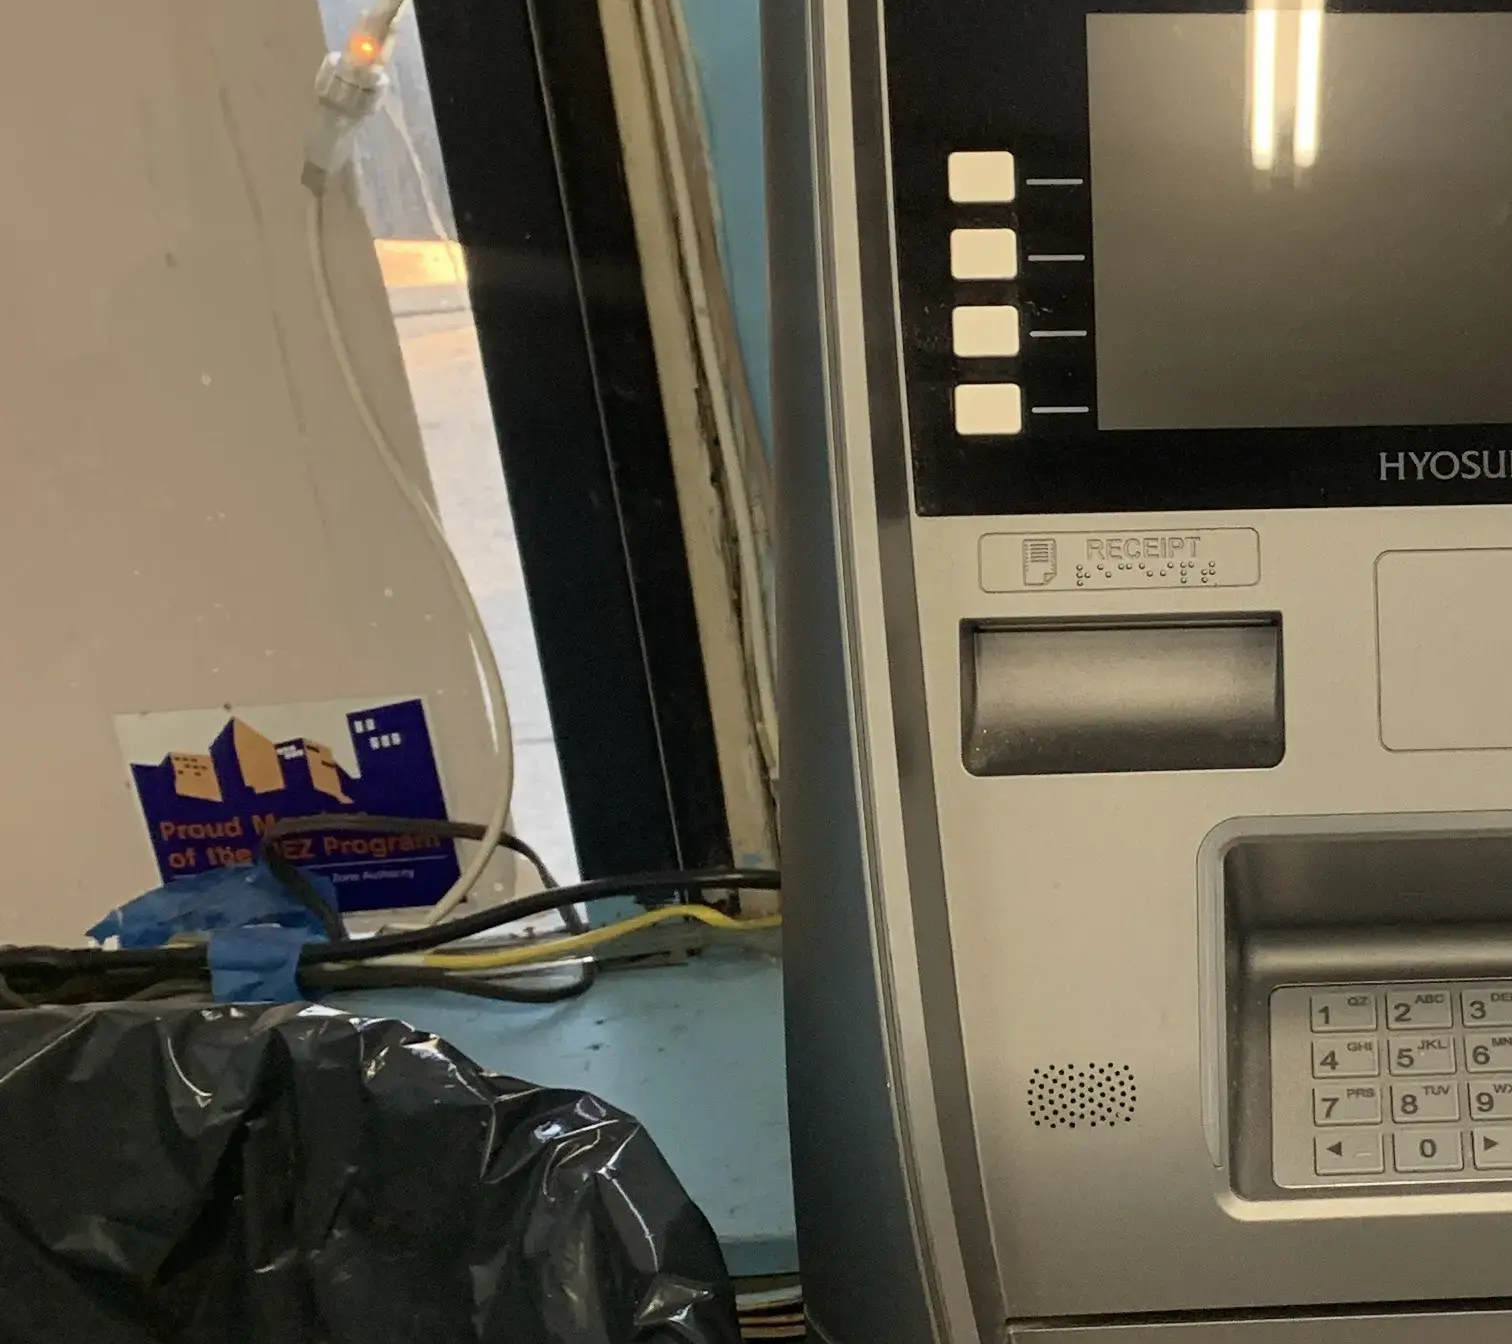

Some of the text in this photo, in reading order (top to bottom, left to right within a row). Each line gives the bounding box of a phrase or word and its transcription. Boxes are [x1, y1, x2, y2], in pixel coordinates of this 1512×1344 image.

[1085, 536, 1201, 561] RECEIPT
[159, 817, 242, 841] Proud
[168, 848, 196, 869] of
[323, 834, 441, 858] Program
[1347, 996, 1368, 1006] QZ
[1414, 994, 1444, 1004] ABC
[1318, 1006, 1330, 1025] 1
[1393, 1003, 1411, 1022] 2
[1469, 1000, 1487, 1019] 3
[1346, 1042, 1373, 1052] GHI
[1417, 1039, 1447, 1050] JKL
[1320, 1051, 1339, 1070] 4
[1396, 1048, 1415, 1068] 5
[1472, 1045, 1491, 1065] 6
[1346, 1088, 1375, 1098] PRS
[1423, 1086, 1450, 1096] TUV
[1321, 1097, 1339, 1118] 7
[1400, 1094, 1419, 1115] 8
[1476, 1092, 1495, 1112] 9
[1419, 1138, 1437, 1158] 0
